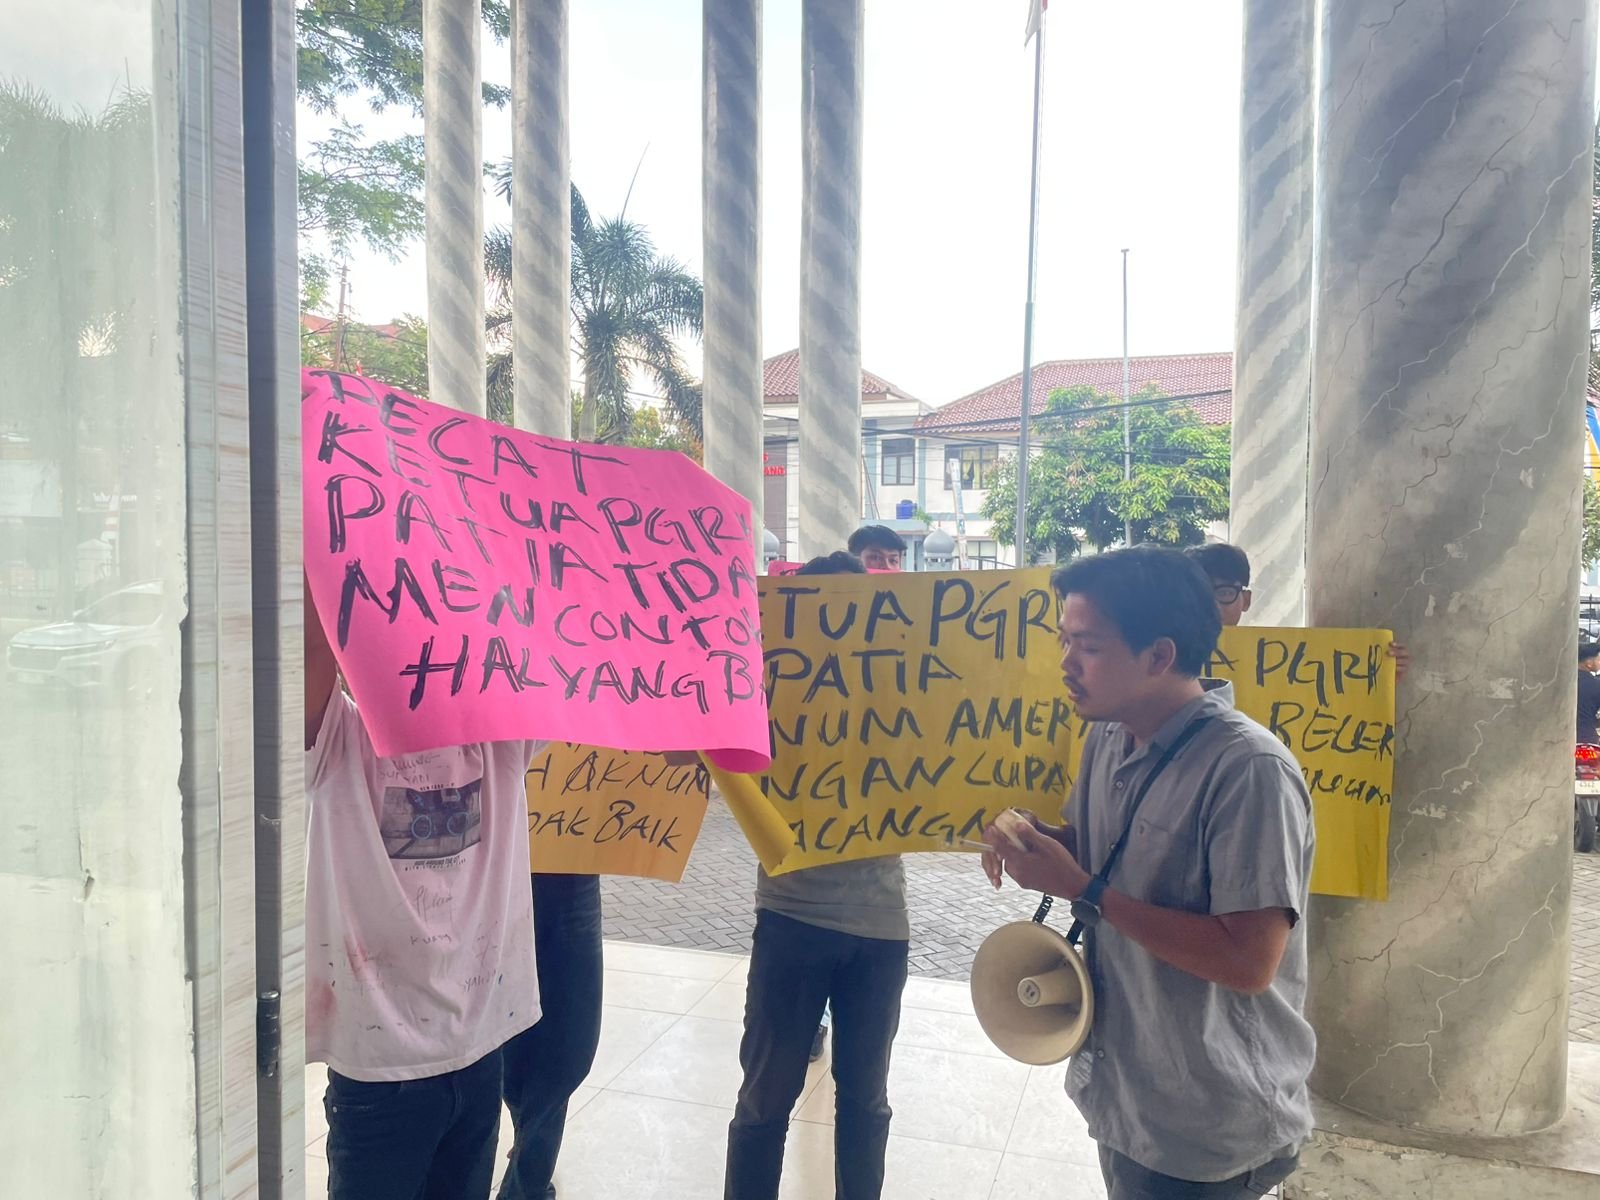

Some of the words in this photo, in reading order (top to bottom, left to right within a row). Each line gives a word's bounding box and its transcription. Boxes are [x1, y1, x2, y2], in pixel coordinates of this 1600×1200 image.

[308, 371, 629, 495] PECAT
[317, 410, 600, 534] KETUA
[325, 474, 608, 590] PATIA
[758, 586, 914, 643] TUA
[762, 648, 963, 710] PATIA
[593, 800, 683, 853] BAIK
